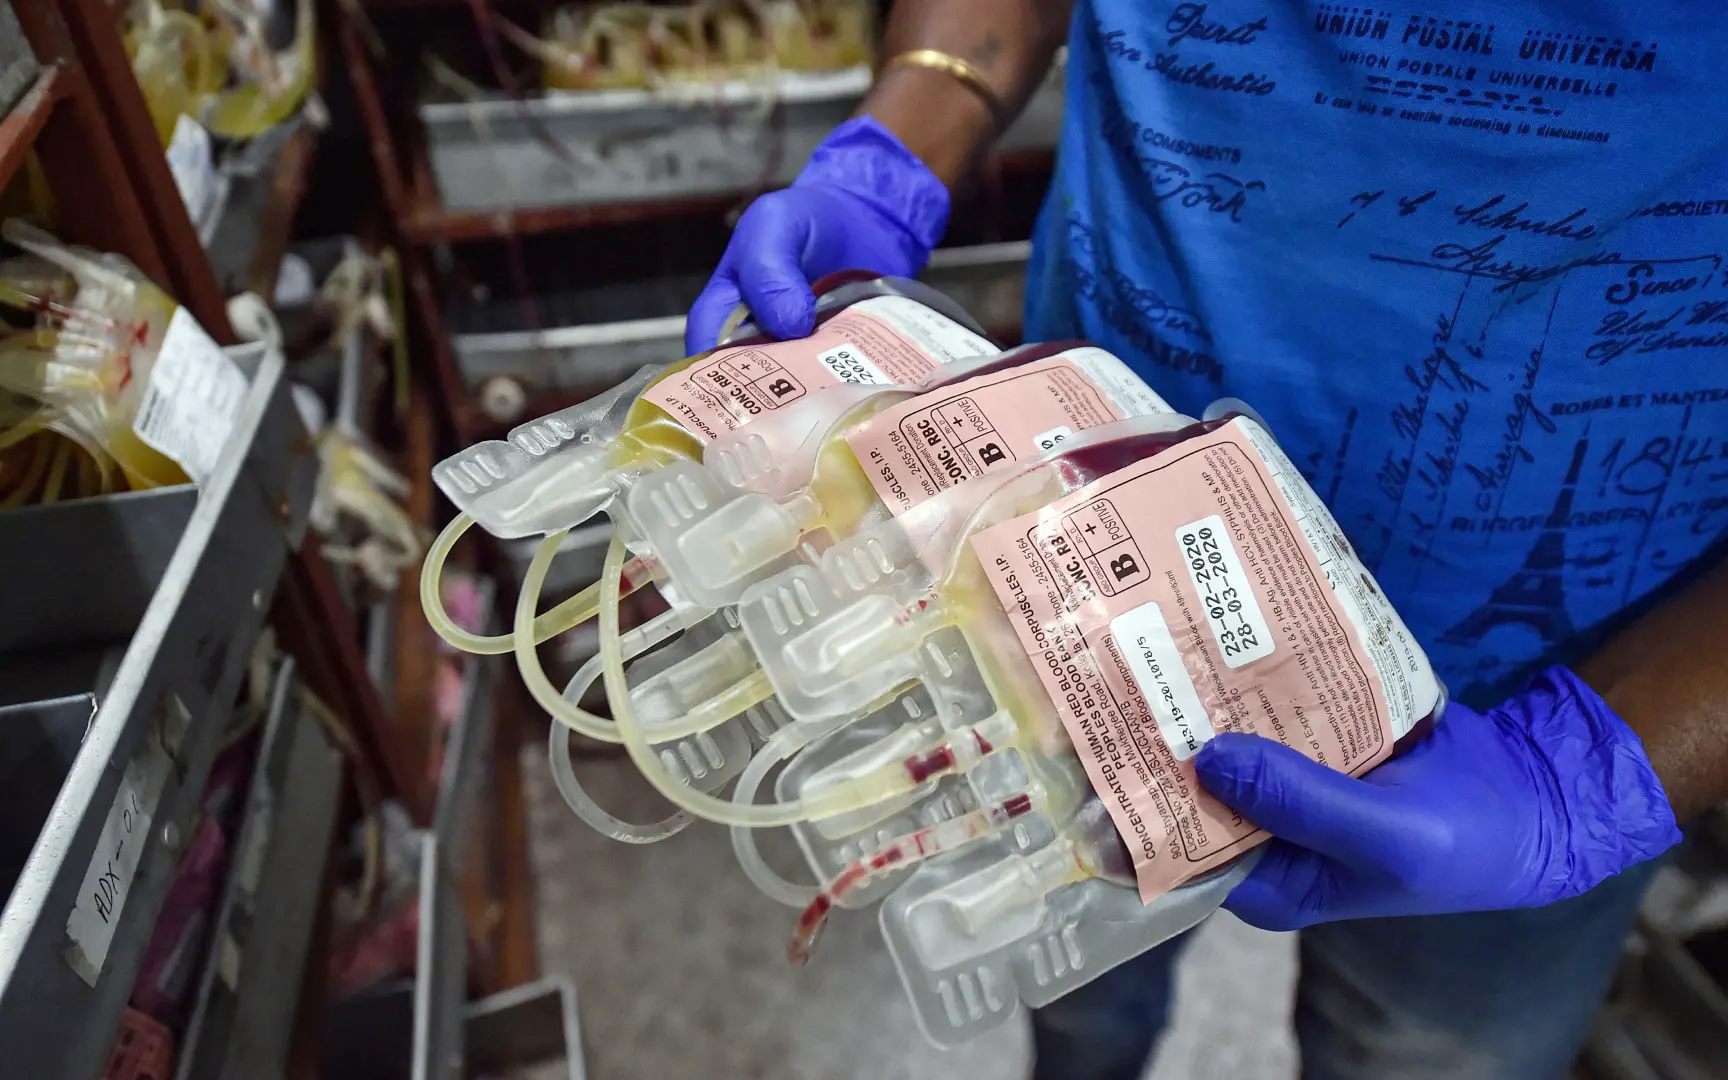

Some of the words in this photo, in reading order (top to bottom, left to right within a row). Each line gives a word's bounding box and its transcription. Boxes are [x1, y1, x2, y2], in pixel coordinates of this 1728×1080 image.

[1339, 51, 1391, 69] UNION
[706, 370, 732, 387] RBC
[768, 378, 796, 398] B
[729, 384, 761, 414] CONC.
[957, 399, 987, 432] POSITIVE
[905, 422, 924, 449] Donation
[916, 419, 941, 446] RBC
[870, 447, 884, 464] I.P.
[887, 430, 920, 475] 2455-5164
[978, 442, 1006, 466] B
[1201, 471, 1215, 486] MP
[1203, 452, 1231, 491] deterioration.
[1216, 455, 1240, 488] medication
[1228, 493, 1241, 509] other
[1236, 488, 1247, 501] add
[1217, 495, 1245, 540] SYPHILIS
[1243, 501, 1253, 513] not
[1091, 501, 1123, 540] POSITIVE
[1251, 513, 1259, 524] Do
[1256, 523, 1266, 534] (3)
[1045, 531, 1071, 556] RB
[1243, 519, 1266, 557] haemolysis
[1266, 522, 1281, 544] before
[1278, 527, 1293, 547] Blood
[995, 554, 1009, 571] I.P.
[1015, 537, 1048, 584] 2455-5164
[1241, 541, 1258, 567] HCV,
[1261, 557, 1270, 565] of
[1272, 553, 1280, 563] be
[1278, 544, 1291, 564] warm
[1290, 546, 1307, 575] Peoples
[1088, 557, 1104, 579] GROUP
[1110, 553, 1140, 582] B
[1253, 567, 1269, 585] Anti
[1276, 562, 1289, 580] must
[1287, 564, 1297, 576] not
[1101, 579, 1111, 592] ABO
[1198, 527, 1258, 649] 28-03-2020
[1267, 566, 1286, 596] evidence
[1294, 576, 1302, 586] do
[1182, 533, 1241, 656] 23-02-2020
[1293, 596, 1304, 610] with
[1298, 586, 1309, 600] and
[1308, 581, 1328, 612] reactions
[1005, 570, 1049, 648] CORPUSCLES,
[1182, 607, 1193, 623] with
[1283, 597, 1297, 619] visible
[1300, 610, 1310, 622] set
[1307, 601, 1317, 614] use
[1189, 624, 1203, 645] Blood
[1282, 622, 1291, 632] 2,
[1292, 620, 1301, 628] of
[1315, 614, 1329, 637] before
[1323, 612, 1340, 636] Report
[1287, 633, 1296, 641] &
[1307, 622, 1329, 660] transfusion
[1336, 635, 1345, 645] (6)
[1044, 650, 1071, 691] BLOOD
[1071, 642, 1096, 679] Kolkta
[1100, 633, 1137, 695] Components)
[1295, 652, 1309, 670] HIV
[1324, 660, 1337, 681] blood
[1066, 664, 1095, 709] BLOOD
[1212, 672, 1226, 697] Whole
[1305, 670, 1320, 689] Anti
[1335, 680, 1349, 701] sterile
[1340, 670, 1355, 690] blood
[1090, 678, 1111, 709] Road,
[1316, 691, 1327, 704] for
[1327, 687, 1337, 700] not
[1352, 689, 1360, 704] Mix
[1066, 693, 1085, 718] RED
[1131, 695, 1152, 723] Blood
[1334, 700, 1343, 712] Do
[1356, 703, 1364, 714] (4)
[1144, 723, 1158, 733] of
[1293, 706, 1313, 738] Expiry
[1339, 712, 1348, 723] (1)
[1079, 718, 1106, 763] HUMAN
[1090, 710, 1125, 769] PEOPLES
[1107, 709, 1136, 761] Mukherjee
[1308, 739, 1319, 749] of
[1323, 705, 1350, 766] Non-reactive
[1346, 729, 1357, 758] Caution
[1153, 734, 1185, 782] production
[1130, 761, 1174, 835] Shyamaprasad
[1177, 783, 1190, 798] for
[1101, 764, 1155, 859] CONCENTRATED
[1168, 797, 1184, 815] No.
[1183, 798, 1209, 847] (Endorsed
[1177, 816, 1197, 853] Licence
